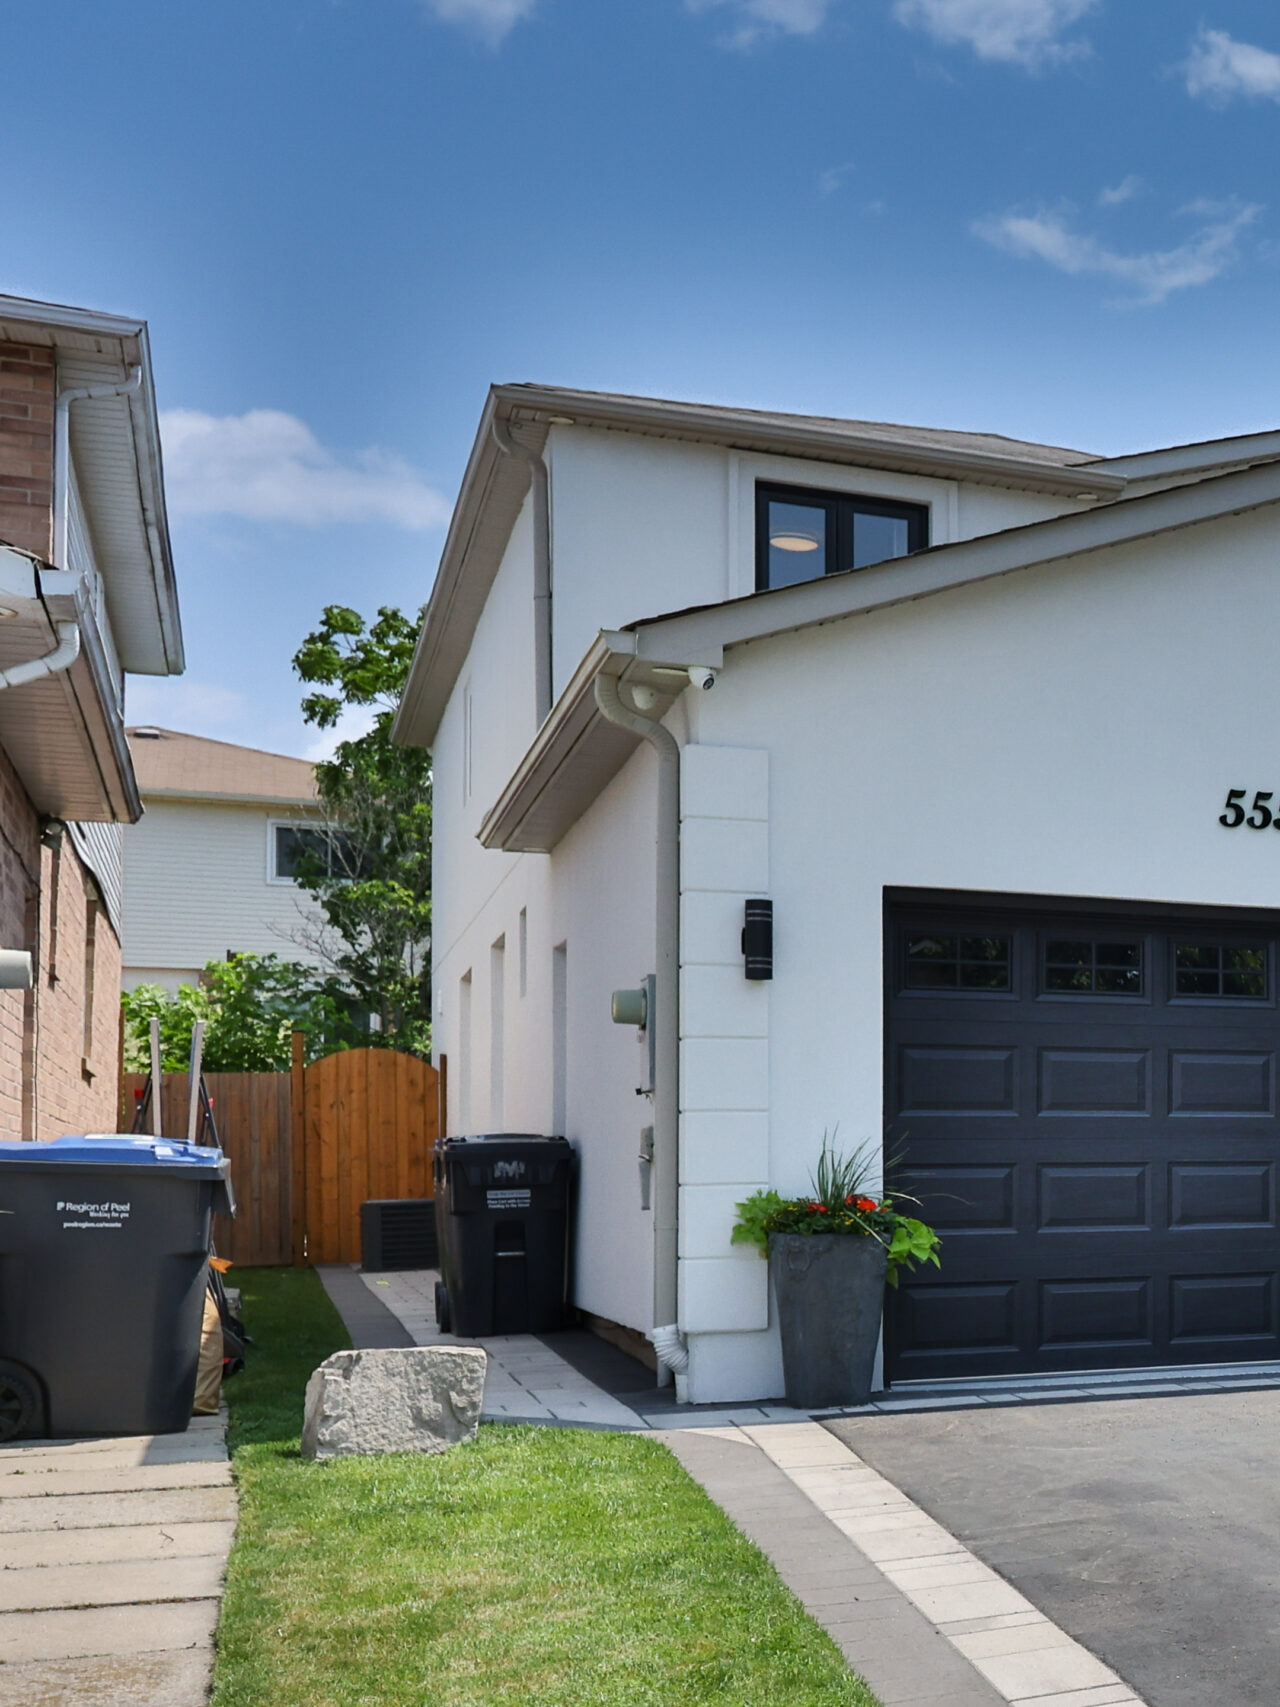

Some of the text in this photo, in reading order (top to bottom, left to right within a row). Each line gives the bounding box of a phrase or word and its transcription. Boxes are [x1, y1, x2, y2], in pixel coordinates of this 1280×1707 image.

[66, 1202, 99, 1213] Region
[100, 1202, 110, 1211] of
[110, 1202, 130, 1211] Peel
